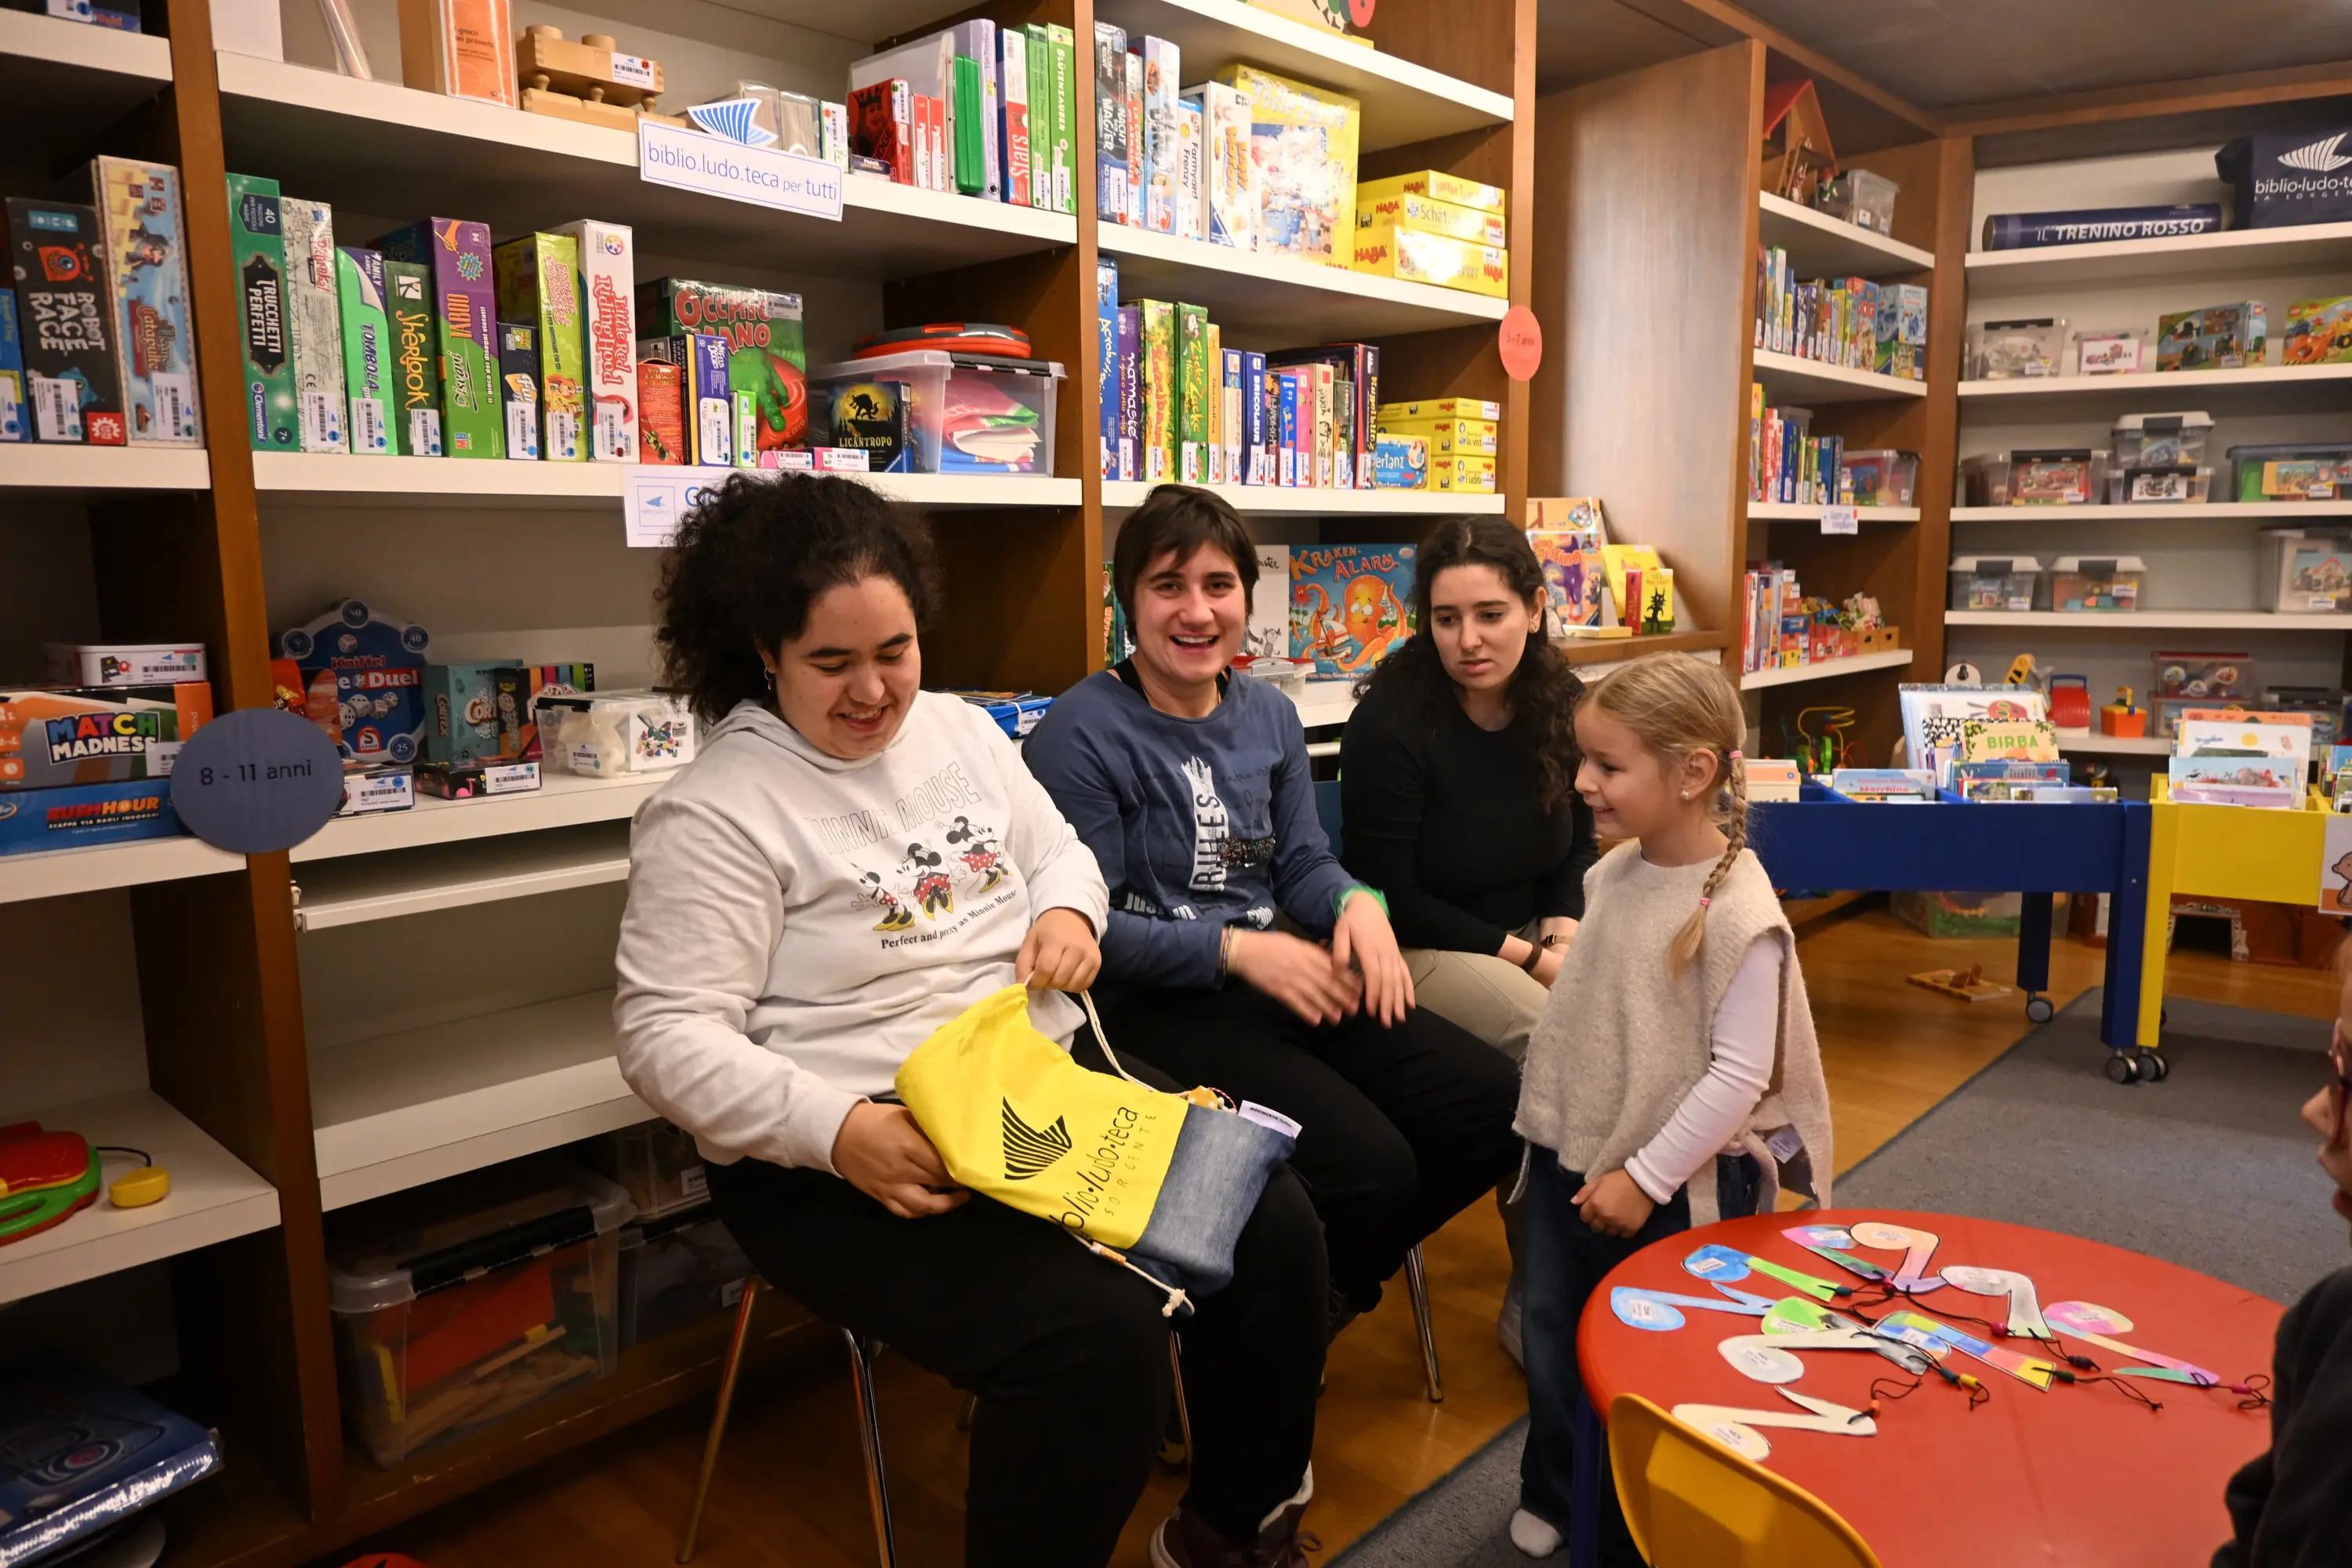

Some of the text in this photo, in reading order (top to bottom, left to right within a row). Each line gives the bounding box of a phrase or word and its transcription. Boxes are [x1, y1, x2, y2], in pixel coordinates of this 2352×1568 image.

[1102, 98, 1116, 151] MAGIER
[1118, 107, 1127, 146] NACHT
[648, 142, 837, 200] biblio.ludo.teca per tutti
[1011, 134, 1029, 178] Stars
[1181, 148, 1190, 188] Frenzy
[1189, 141, 1198, 199] Farmyard
[1403, 181, 1426, 194] HABA
[265, 209, 276, 224] 40
[1376, 201, 1399, 214] HABA
[2056, 222, 2136, 241] TRENINO
[2141, 218, 2205, 236] ROSSO
[364, 253, 372, 274] GAMES
[372, 250, 383, 287] FAMILY
[1354, 245, 1387, 264] HABA
[1483, 263, 1504, 283] HABA
[545, 274, 567, 326] ESSERE
[554, 262, 578, 316] ESSERE
[29, 292, 61, 350] RACE
[54, 292, 89, 352] FACE
[77, 292, 106, 351] ROBOT
[249, 287, 266, 347] PERFETTI
[256, 278, 281, 354] TRUCCHETTI
[446, 292, 474, 339] TABOO
[592, 274, 624, 386] Riding Hood
[483, 334, 492, 361] disegni
[614, 296, 632, 375] Little Red
[361, 322, 381, 393] TOMBOLA
[1189, 339, 1205, 387] Zicke
[446, 350, 470, 408] Disegni
[485, 374, 495, 396] gioco
[1126, 351, 1139, 441] namasté
[253, 394, 266, 441] Clementoni
[279, 430, 289, 442] 7+
[455, 431, 467, 449] MB
[839, 436, 893, 448] LICANTROPO
[1334, 554, 1400, 582] ALARM
[331, 654, 387, 670] Kniffel
[368, 670, 419, 688] Duel
[47, 713, 159, 744] MATCH
[52, 735, 158, 761] MADNESS
[1987, 735, 2039, 749] BIRBA
[200, 767, 214, 786] 8
[238, 764, 257, 782] 11
[267, 759, 312, 779] anni
[895, 761, 982, 833] MOUSE
[49, 821, 78, 829] SCAPPA
[880, 935, 919, 949] Perfect
[920, 931, 938, 942] and
[958, 916, 969, 927] as
[967, 902, 996, 920] Minnie
[994, 889, 1018, 906] Mouse
[1250, 1106, 1279, 1120] MOVIMENTO
